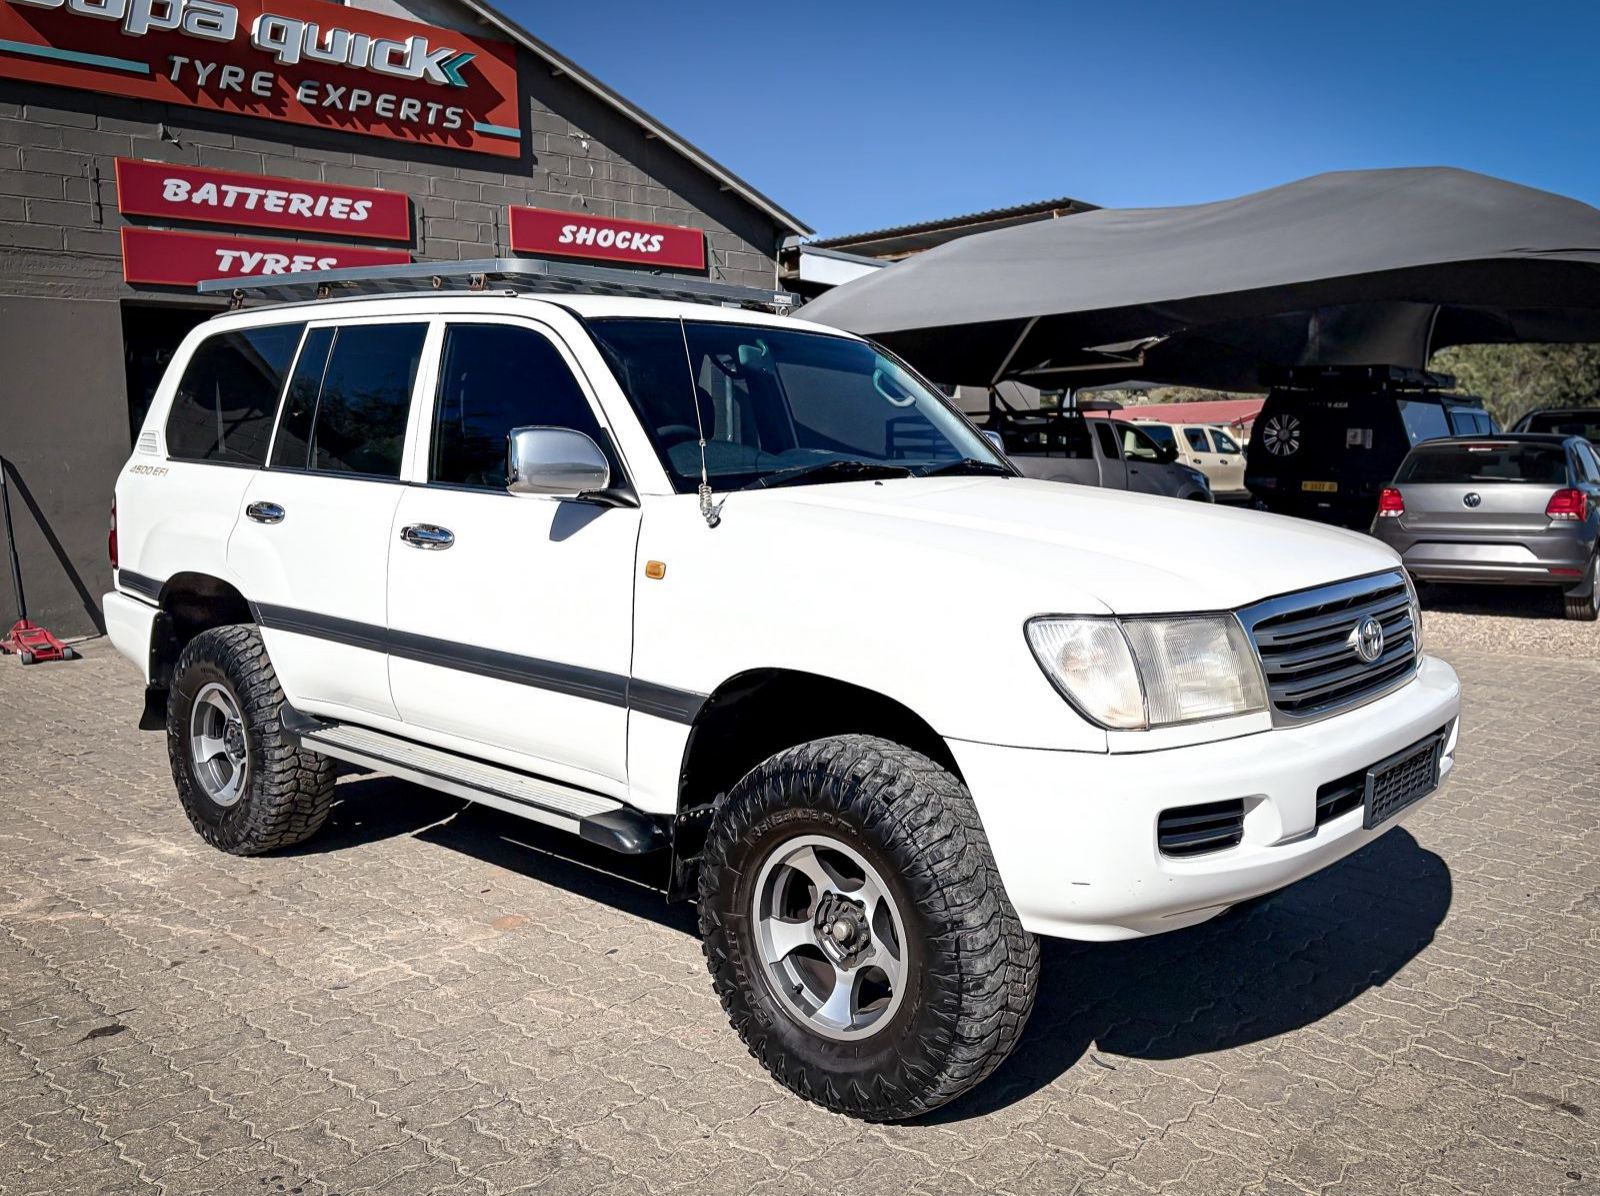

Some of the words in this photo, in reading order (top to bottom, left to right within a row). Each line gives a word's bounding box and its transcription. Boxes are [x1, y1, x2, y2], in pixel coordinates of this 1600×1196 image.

[5, 0, 238, 42] upa
[252, 13, 457, 85] quick
[169, 55, 274, 97] TYRE
[297, 80, 464, 129] EXPERTS
[163, 178, 373, 221] BATTERIES
[558, 224, 664, 253] SHOCKS
[216, 249, 337, 275] TYRES
[129, 464, 154, 475] 4500
[152, 466, 169, 477] EFI
